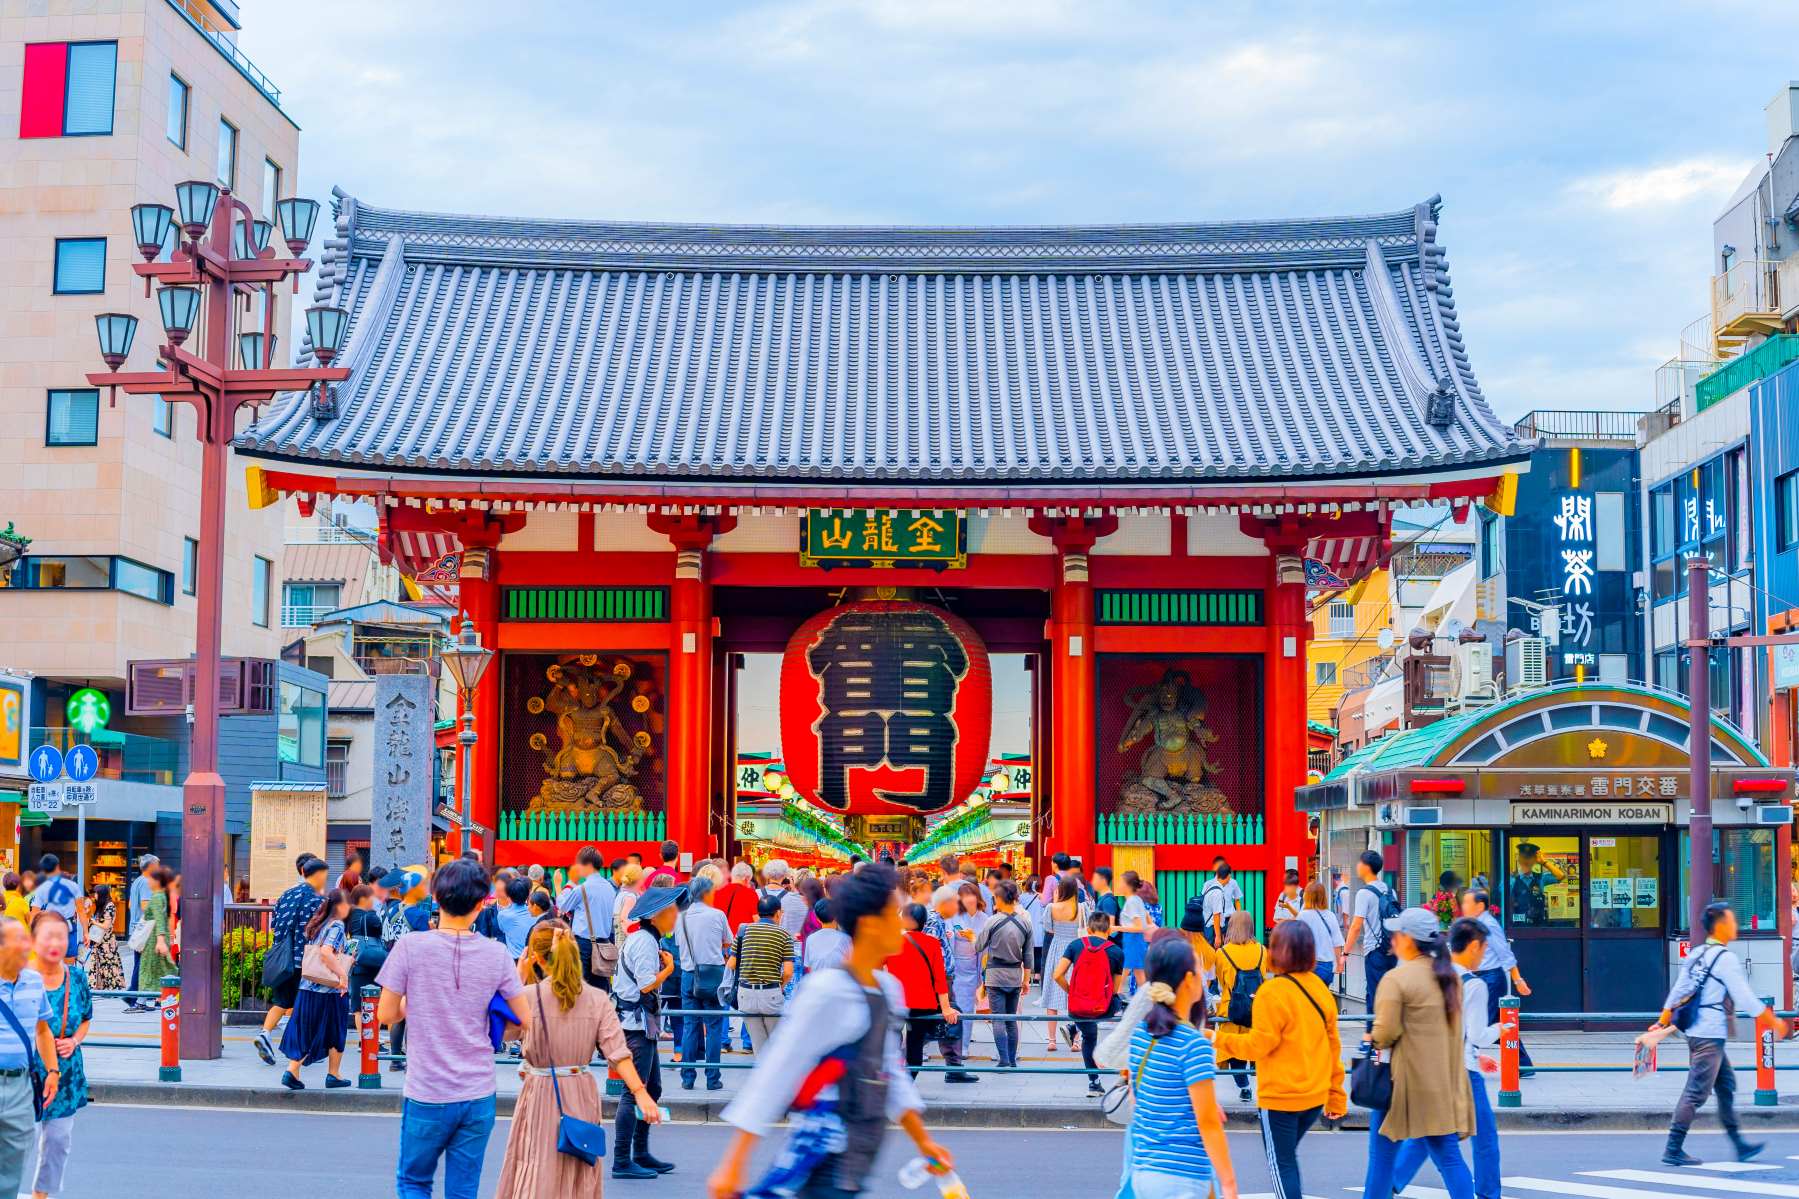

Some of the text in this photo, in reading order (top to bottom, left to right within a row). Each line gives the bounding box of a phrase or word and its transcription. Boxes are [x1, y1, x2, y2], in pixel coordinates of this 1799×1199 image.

[1564, 653, 1595, 665] 雷門店
[805, 610, 970, 811] 雷門
[1590, 776, 1678, 796] 雷門交番
[1522, 808, 1661, 819] KAMINARIMON KOBAN
